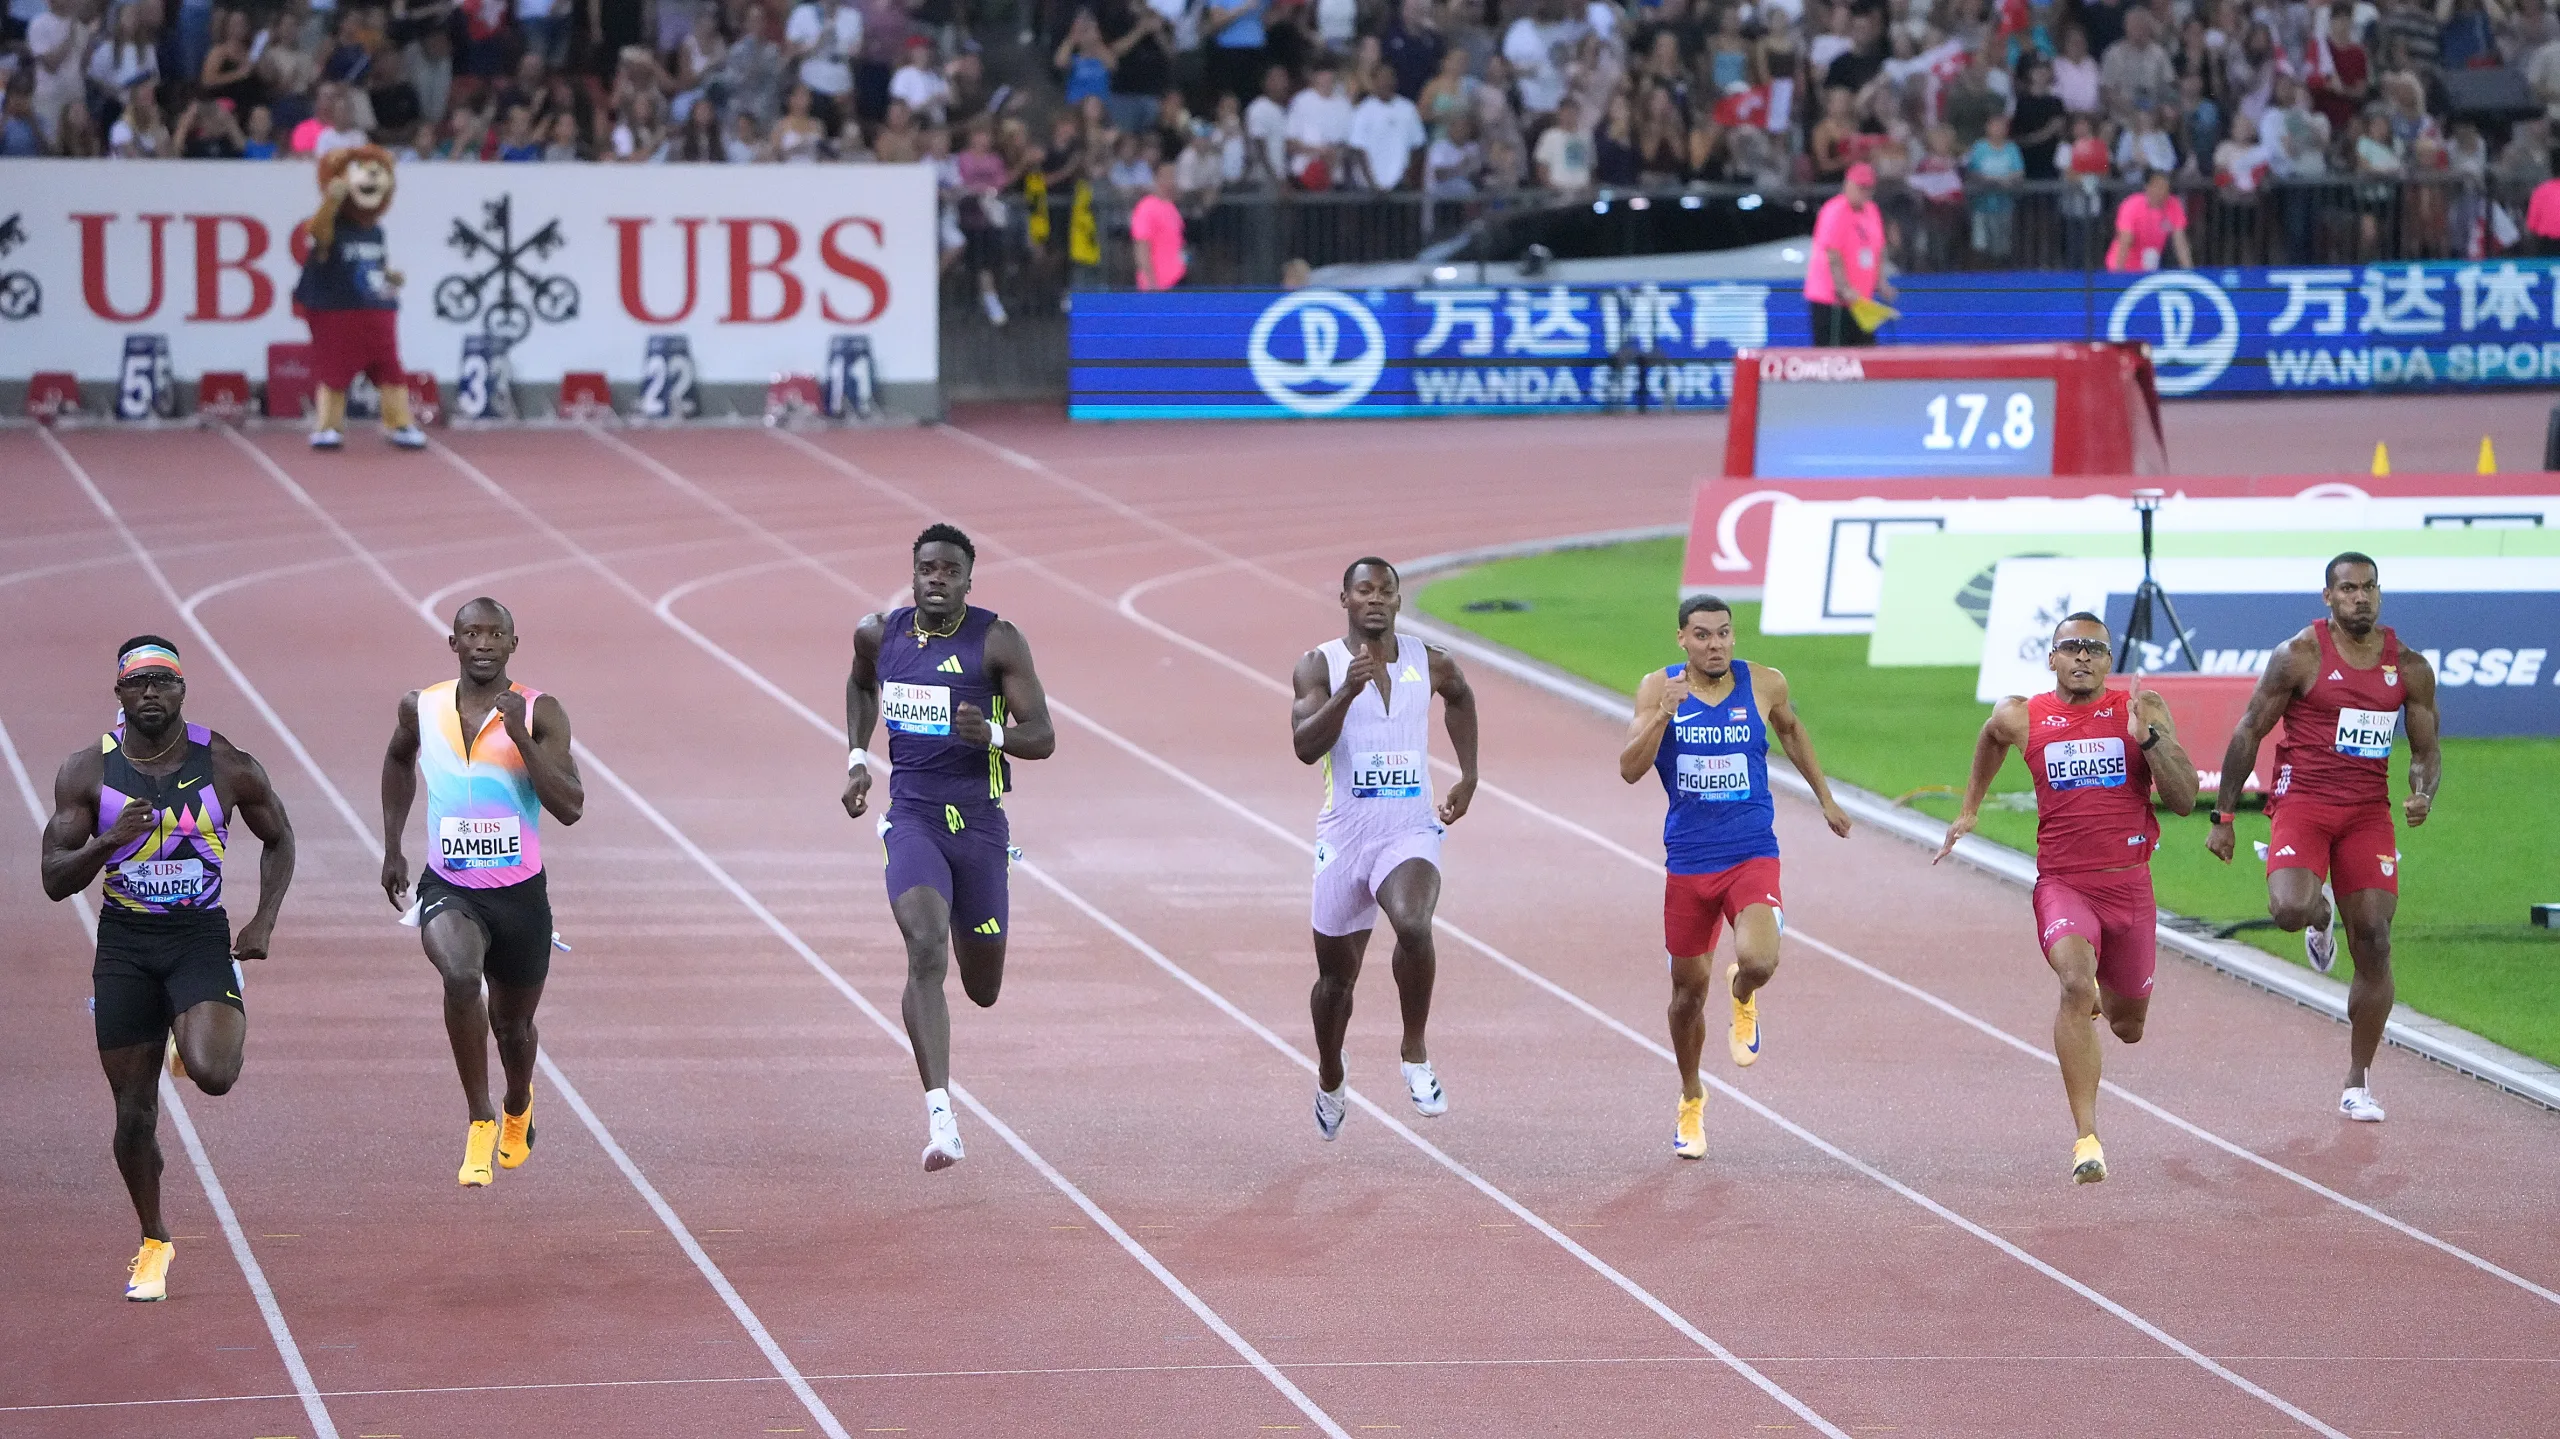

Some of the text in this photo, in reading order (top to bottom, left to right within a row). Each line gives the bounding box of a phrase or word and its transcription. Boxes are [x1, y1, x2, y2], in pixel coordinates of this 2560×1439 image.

[606, 216, 890, 325] UBS
[1784, 356, 1864, 381] OMEGA
[2266, 347, 2434, 386] WANDA
[121, 355, 153, 415] 5
[458, 355, 488, 414] 3
[1413, 366, 1581, 404] WANDA
[1923, 391, 2035, 450] 17.8
[907, 688, 932, 700] UBS
[1675, 725, 1751, 744] PUERTO RICO
[2339, 726, 2392, 746] MENA
[2079, 742, 2105, 754] UBS
[1387, 754, 1409, 765] UBS
[1708, 758, 1731, 769] UBS
[2048, 757, 2125, 779] DE GRASSE
[1354, 769, 1420, 786] LEVELL
[1678, 772, 1748, 789] FIGUEROA
[1377, 788, 1406, 797] ZURICH
[473, 821, 501, 833] UBS
[441, 836, 520, 855] DAMBILE
[154, 863, 183, 876] UBS
[466, 858, 499, 868] ZURICH
